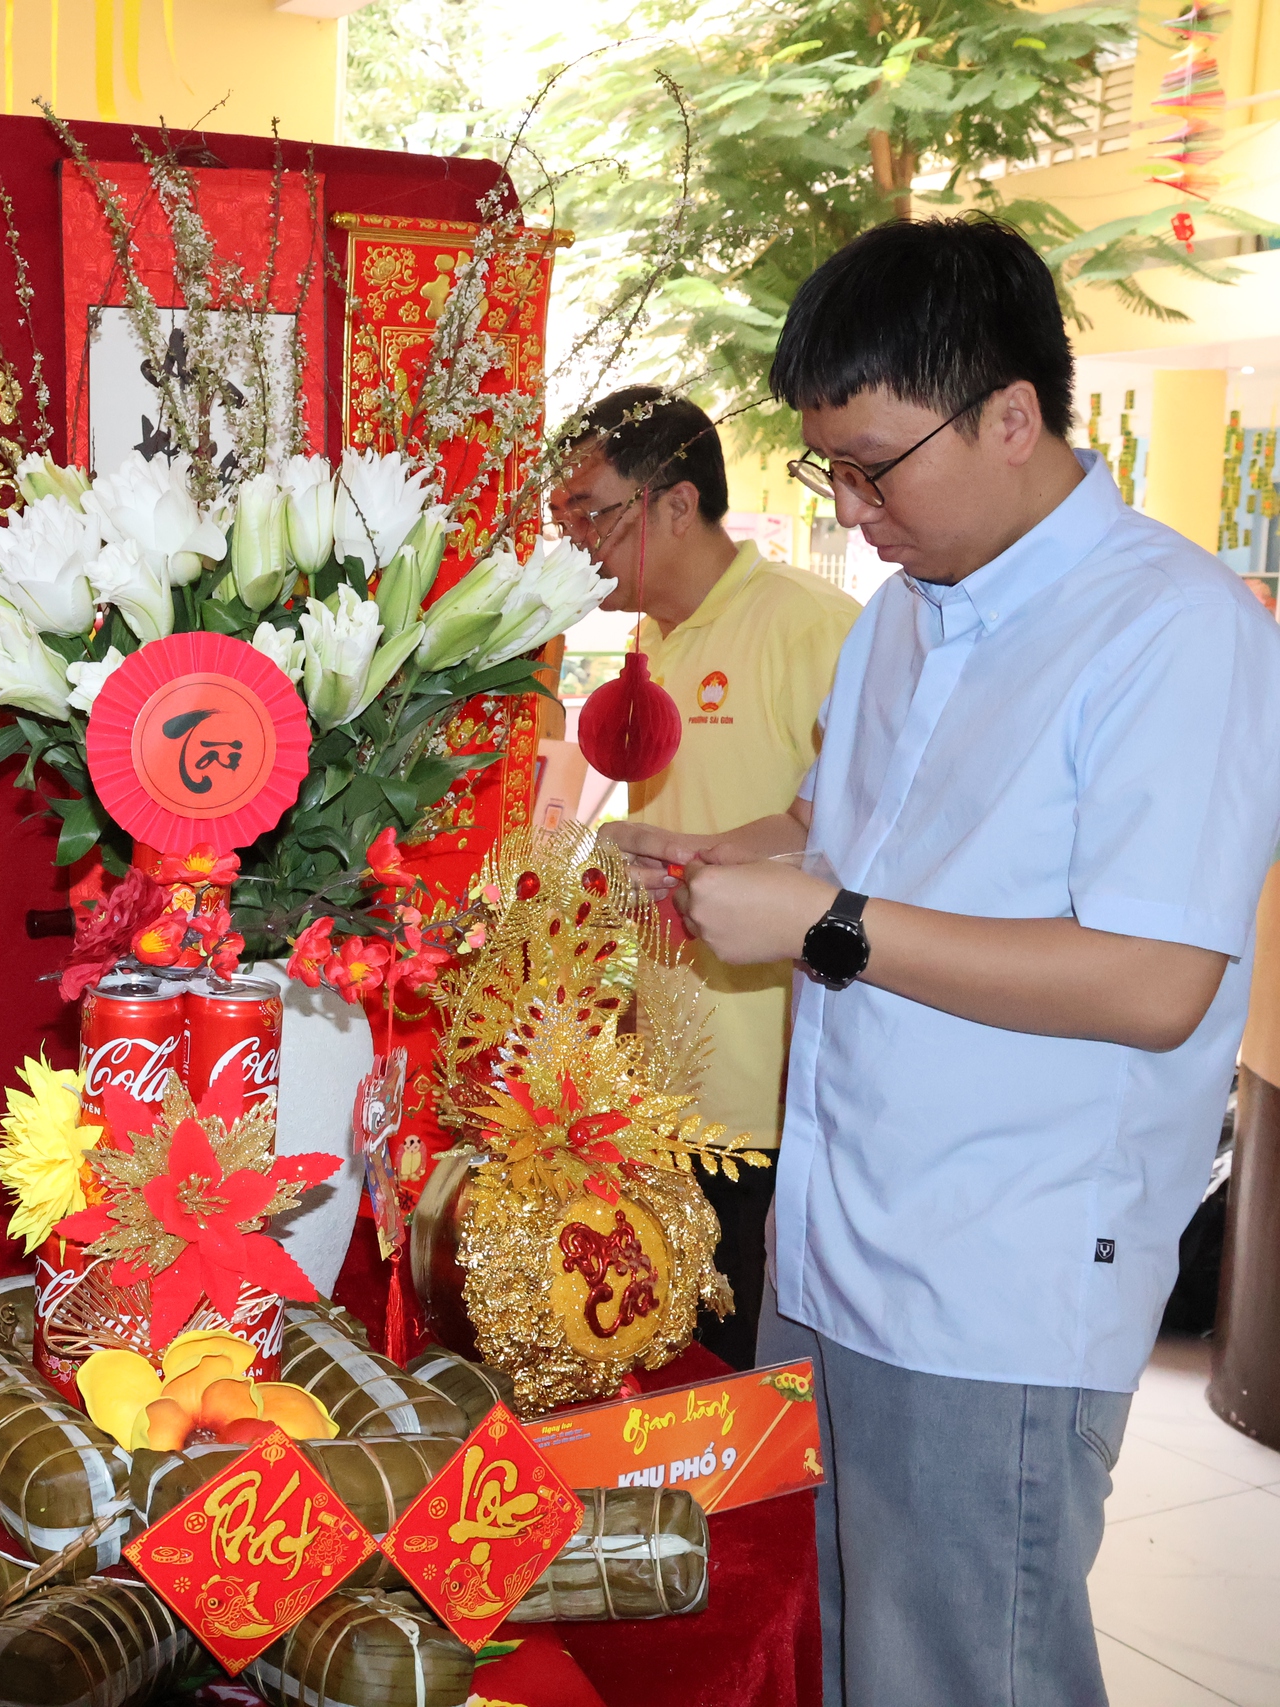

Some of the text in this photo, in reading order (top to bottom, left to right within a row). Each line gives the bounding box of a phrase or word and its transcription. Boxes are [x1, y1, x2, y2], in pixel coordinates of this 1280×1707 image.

[448, 1445, 546, 1563] Lộc
[618, 1442, 738, 1488] KHU PHỐ 9
[203, 1470, 320, 1581] Phát
